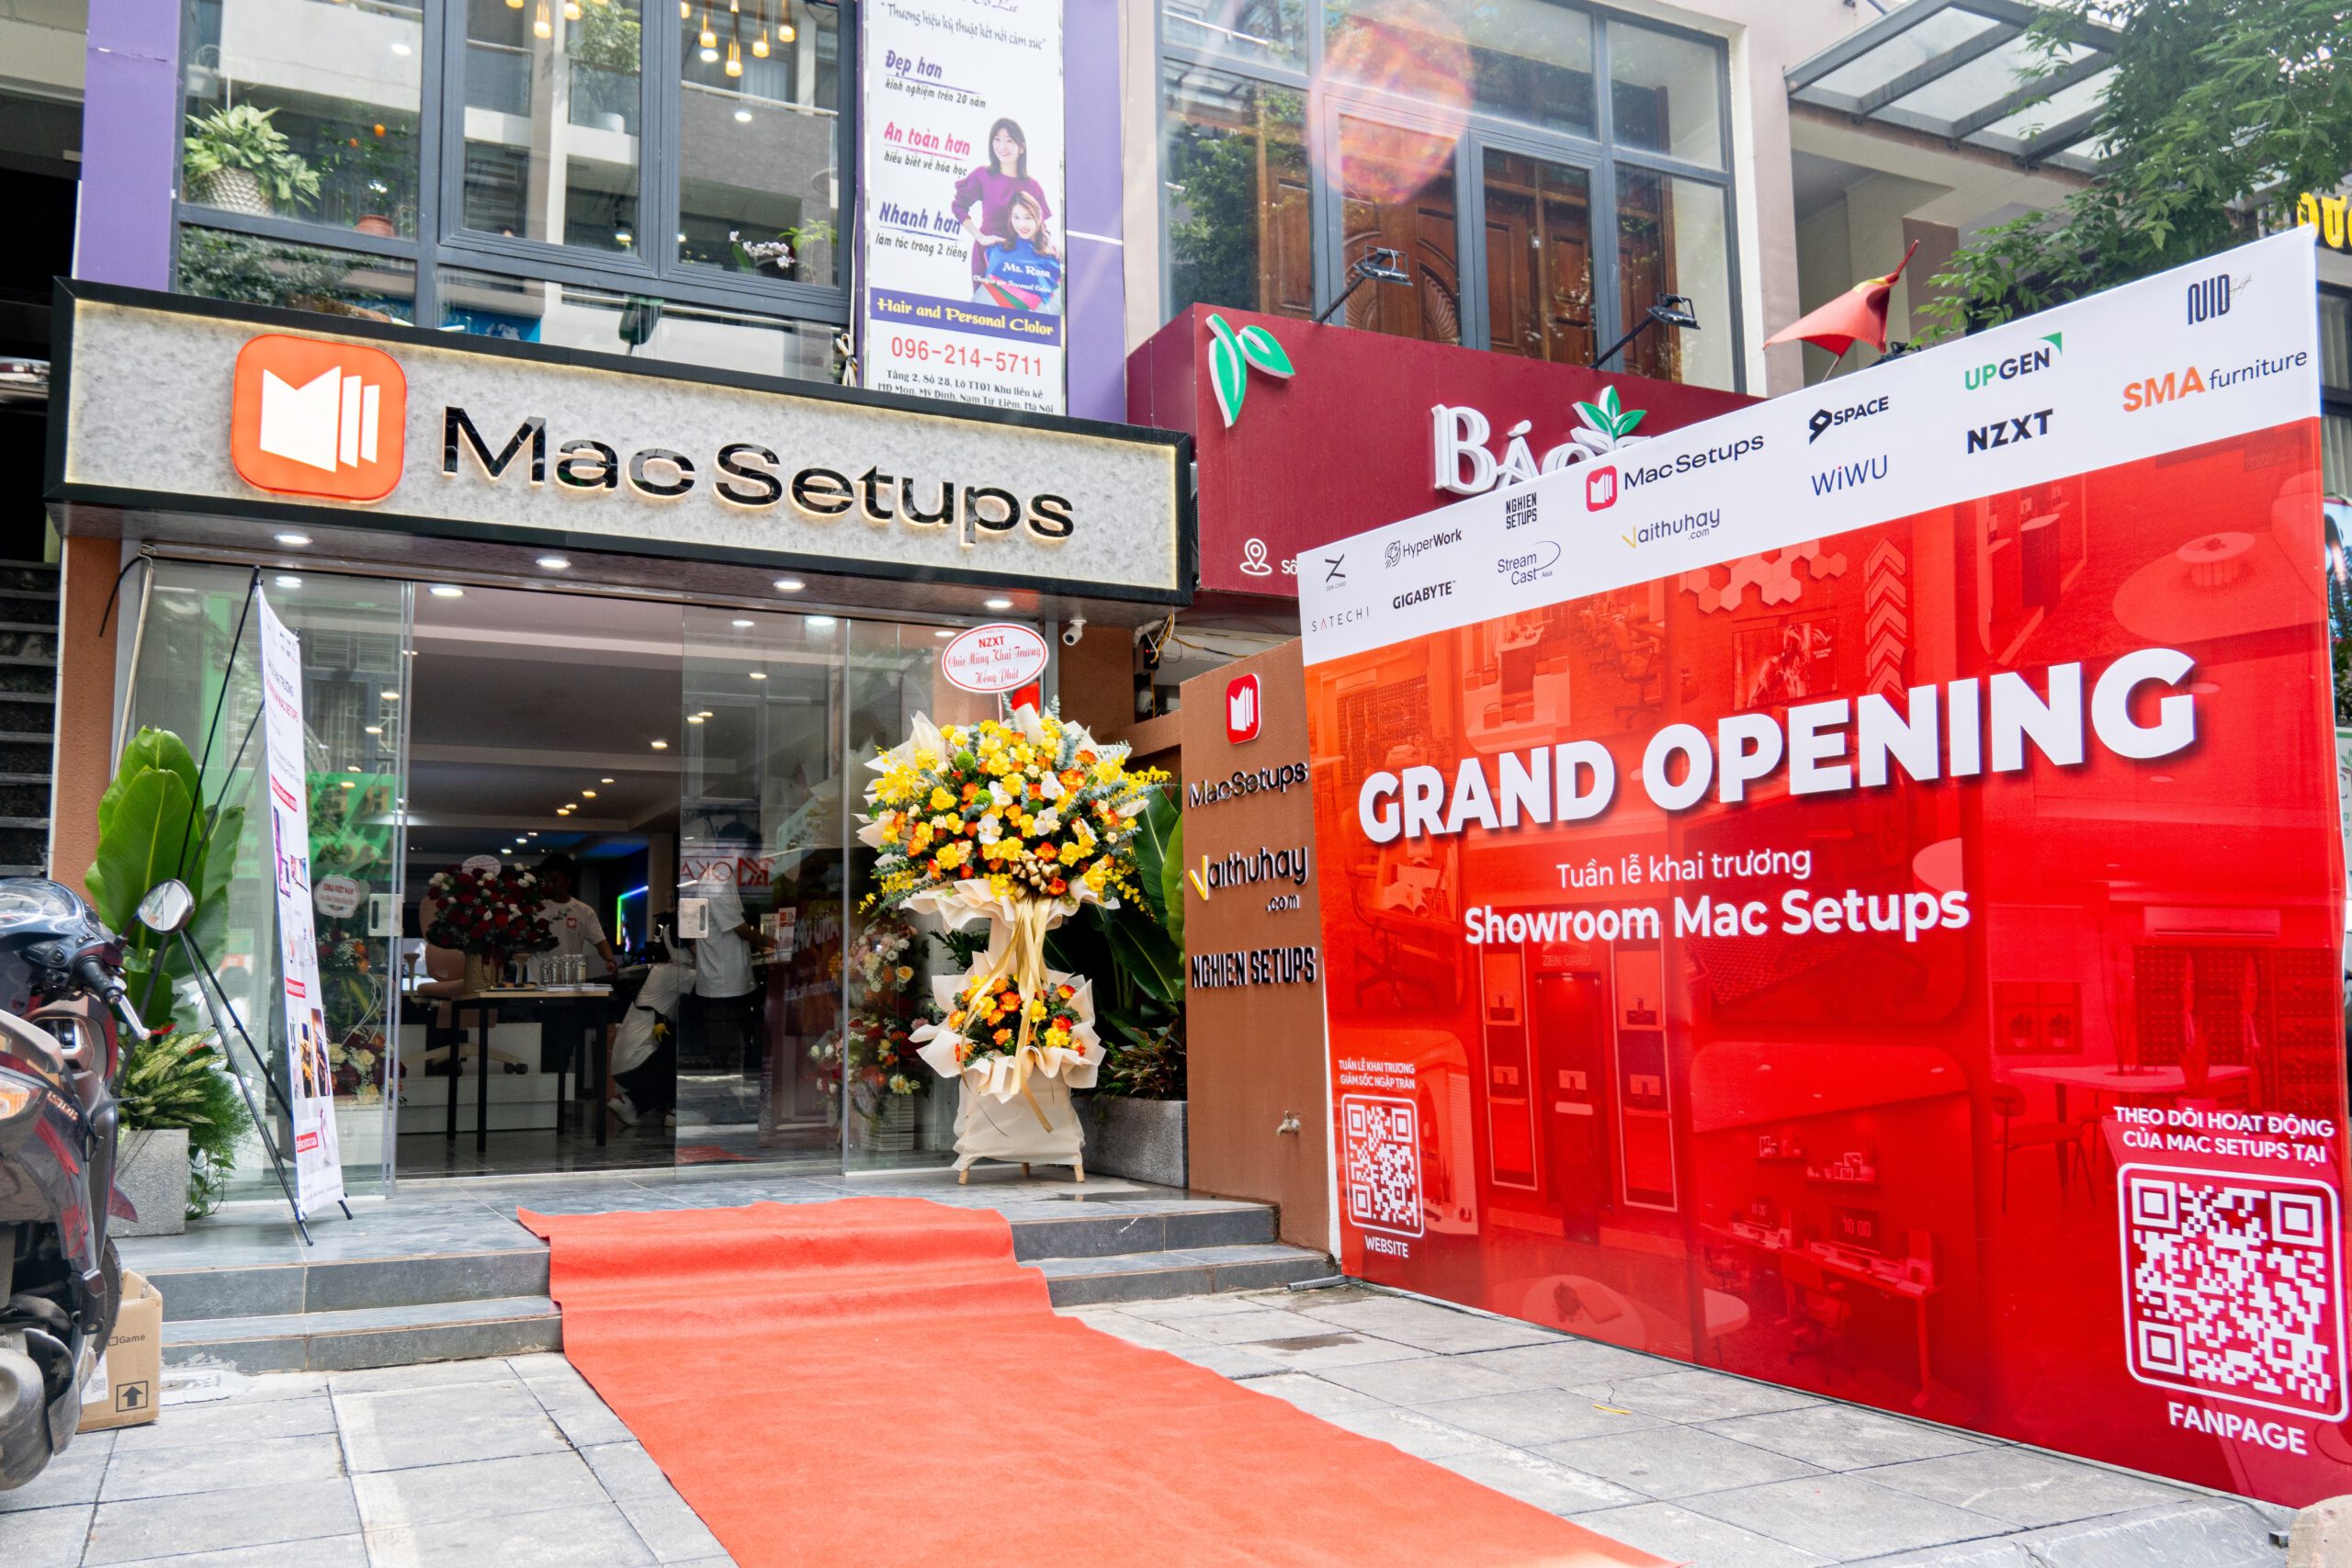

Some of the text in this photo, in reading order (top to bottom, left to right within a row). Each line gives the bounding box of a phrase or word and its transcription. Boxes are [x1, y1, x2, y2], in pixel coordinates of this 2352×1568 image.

[885, 50, 943, 79] Đẹp hơn
[885, 78, 903, 92] kinh
[906, 83, 935, 100] nghiệm
[956, 93, 967, 105] 20
[884, 121, 971, 156] An toàn hơn
[878, 201, 961, 235] Nhanh hơn
[911, 240, 934, 255] trong
[937, 243, 944, 255] 2
[1002, 262, 1023, 274] Ms.
[877, 298, 913, 314] Hair
[916, 304, 941, 320] and
[944, 308, 1006, 330] Personal
[891, 336, 1042, 377] 096-214-5711
[1964, 347, 2051, 391] UPGEN
[968, 381, 990, 391] TT01
[994, 384, 1012, 394] Khu
[2122, 351, 2308, 413] SMA furniture
[1966, 408, 2053, 454] NZXT
[1811, 454, 1887, 496] WiWU
[1506, 491, 1538, 514] NGHIEN
[1506, 507, 1538, 530] SETUPS
[1402, 528, 1463, 558] HyperWork
[1498, 551, 1538, 574] Stream
[1510, 568, 1538, 585] Cast
[978, 636, 1005, 649] NZXT
[1358, 648, 2197, 844] GRAND OPENING
[1556, 847, 1812, 889] Tuần lễ khai trương
[1265, 894, 1301, 912] .com
[1464, 889, 1970, 946] Showroom Mac Setups
[1191, 946, 1317, 988] NGHIEN SETUPS
[1339, 1058, 1357, 1072] TUẦN
[1367, 1061, 1384, 1073] KHAI
[1385, 1061, 1415, 1074] TRƯƠNG
[1340, 1072, 1416, 1090] GIẢM SỐC NGẬP TRÀN
[2114, 1106, 2335, 1139] THEO DÕI HOẠT ĐỘNG
[2123, 1126, 2326, 1168] CỦA MAC SETUPS TẠI
[1364, 1235, 1409, 1258] WEBSITE
[119, 1334, 146, 1344] Game
[2166, 1401, 2308, 1457] FANPAGE
